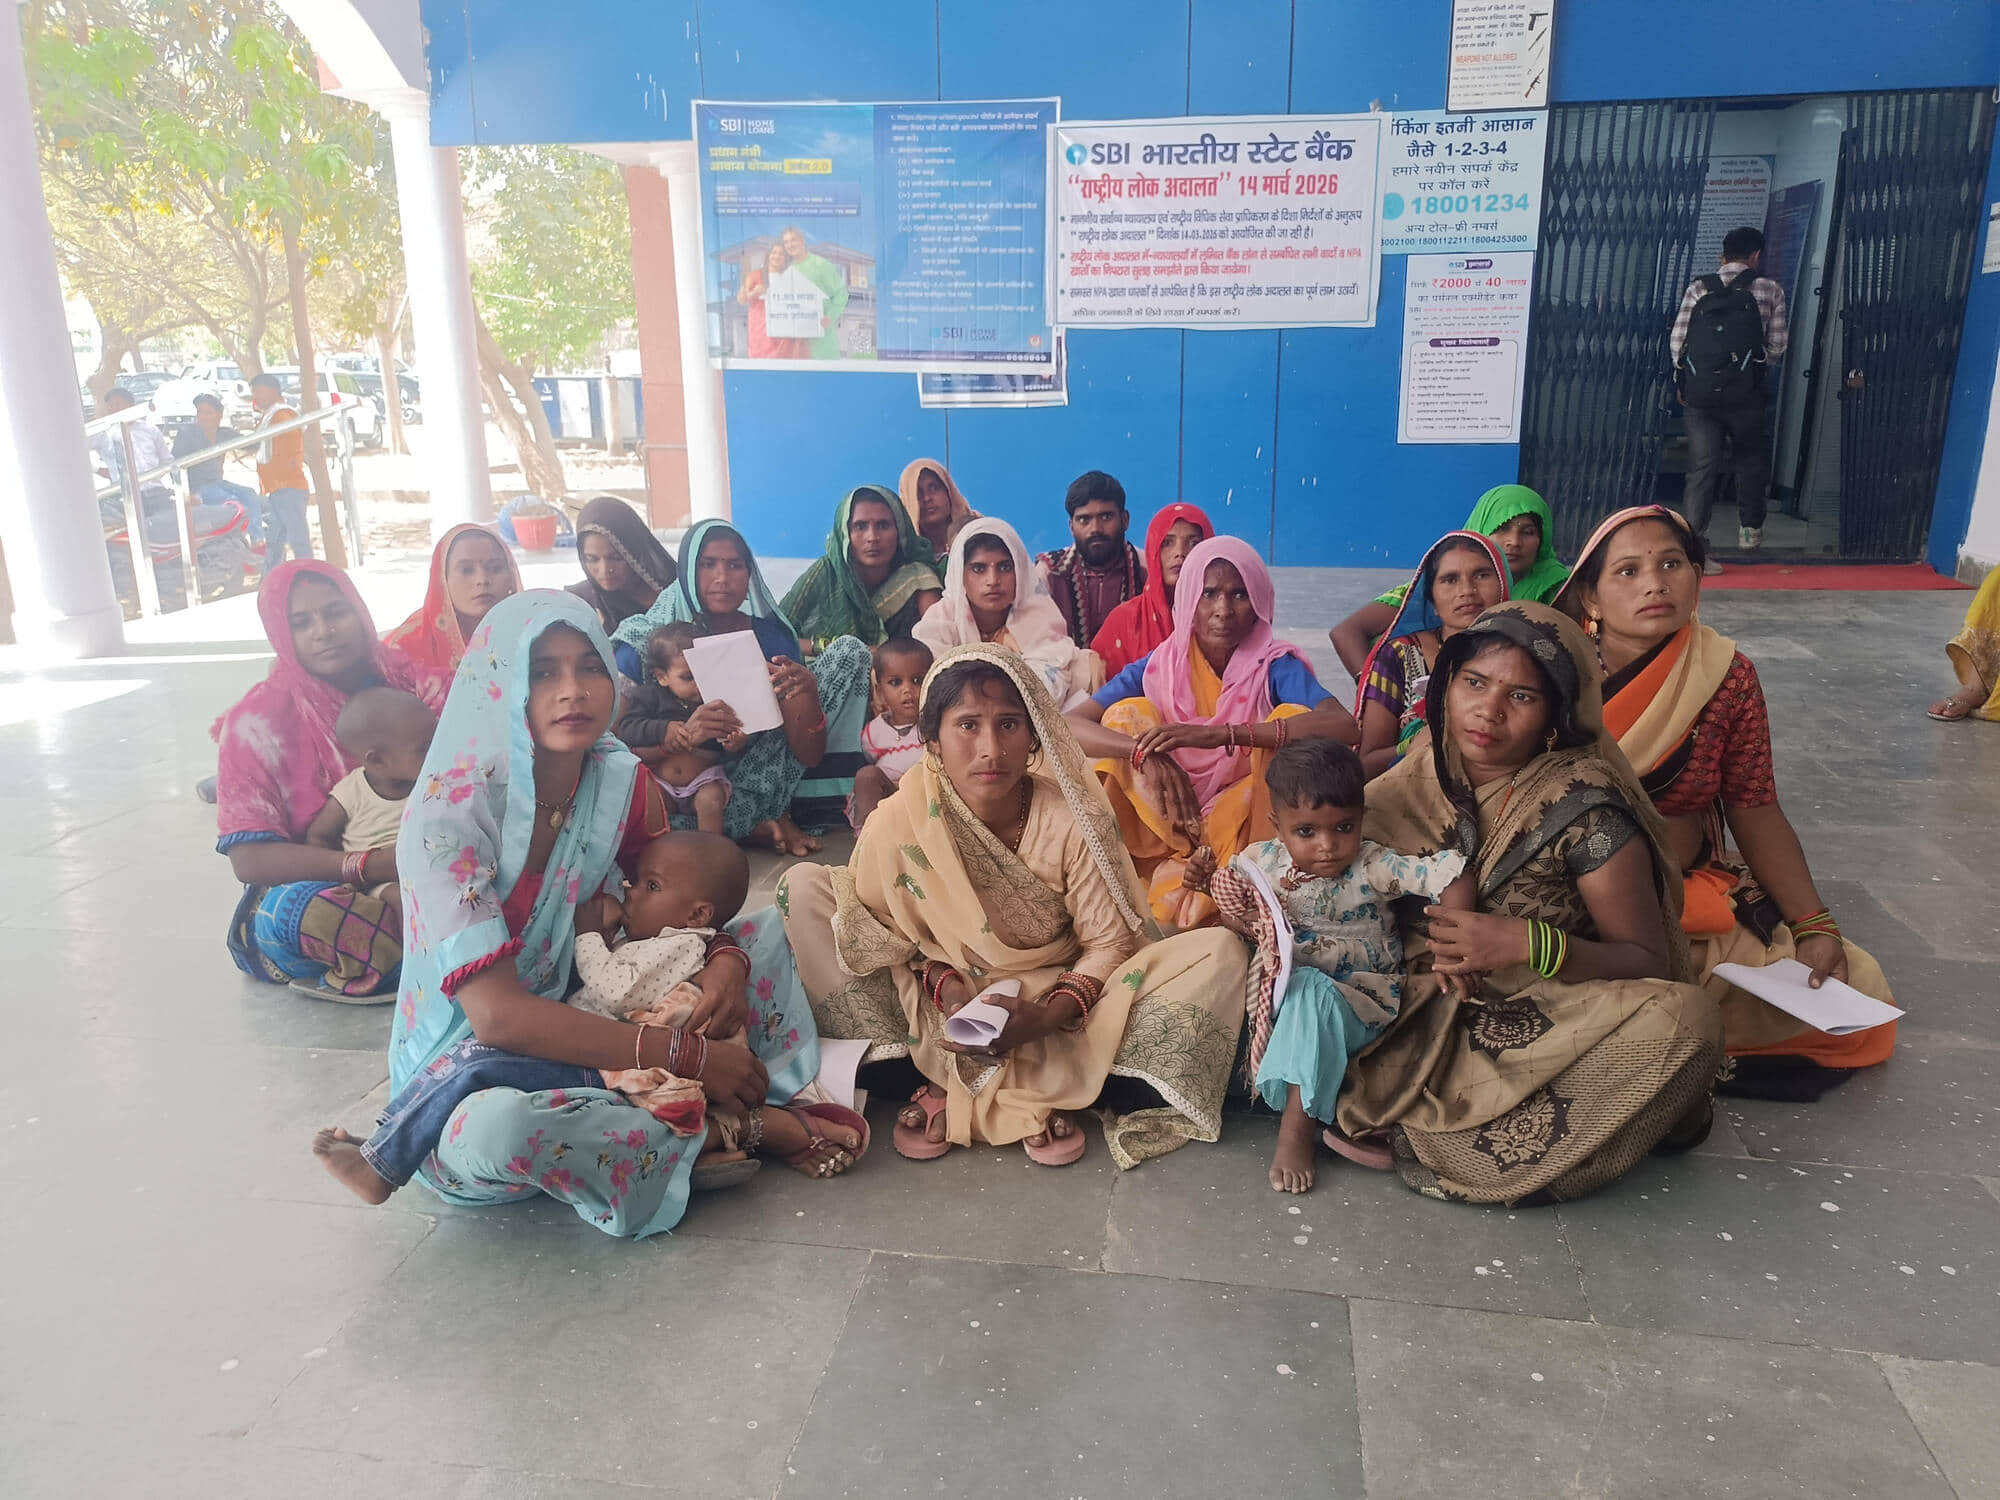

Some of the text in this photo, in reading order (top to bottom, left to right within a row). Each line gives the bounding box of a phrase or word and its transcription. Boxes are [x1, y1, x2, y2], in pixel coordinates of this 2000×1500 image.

[720, 119, 741, 132] SBI
[1436, 115, 1476, 136] इतनी
[1481, 116, 1536, 131] आसान
[1091, 130, 1356, 165] SBI भारतीय स्टेट बैंक
[1407, 140, 1507, 157] जैसे 1-2-3-4
[1393, 166, 1420, 176] हमारे
[1425, 164, 1455, 175] नवीन
[1128, 172, 1159, 198] लोक
[1239, 176, 1257, 196] 14
[1262, 168, 1293, 196] मार्च
[1295, 173, 1338, 195] 2026
[1419, 176, 1489, 191] पर कॉल करें
[1411, 193, 1529, 214] 18001234
[1219, 210, 1233, 222] सेवा
[1235, 208, 1268, 223] प्राधिकरण
[1271, 210, 1279, 221] के
[1281, 208, 1297, 221] दिशा
[1325, 209, 1333, 220] के
[1335, 210, 1362, 225] अनुरूप
[1102, 229, 1118, 241] लोक
[1120, 231, 1146, 240] अदालत
[1157, 227, 1179, 240] दिनांक
[1266, 225, 1276, 238] की
[1278, 229, 1287, 238] जा
[1290, 225, 1302, 239] रही
[1405, 223, 1425, 233] अन्य
[1419, 236, 1468, 245] 1800112211
[1471, 235, 1527, 244] 18004253800
[1432, 278, 1471, 288] ₹2000
[1486, 277, 1501, 287] 40
[1209, 287, 1220, 297] इस
[1223, 283, 1244, 300] राष्ट्रीय
[1246, 284, 1263, 297] लोक
[1264, 286, 1291, 296] अदालत
[1294, 286, 1304, 295] का
[1320, 286, 1335, 295] लाभ
[943, 328, 962, 338] SBI
